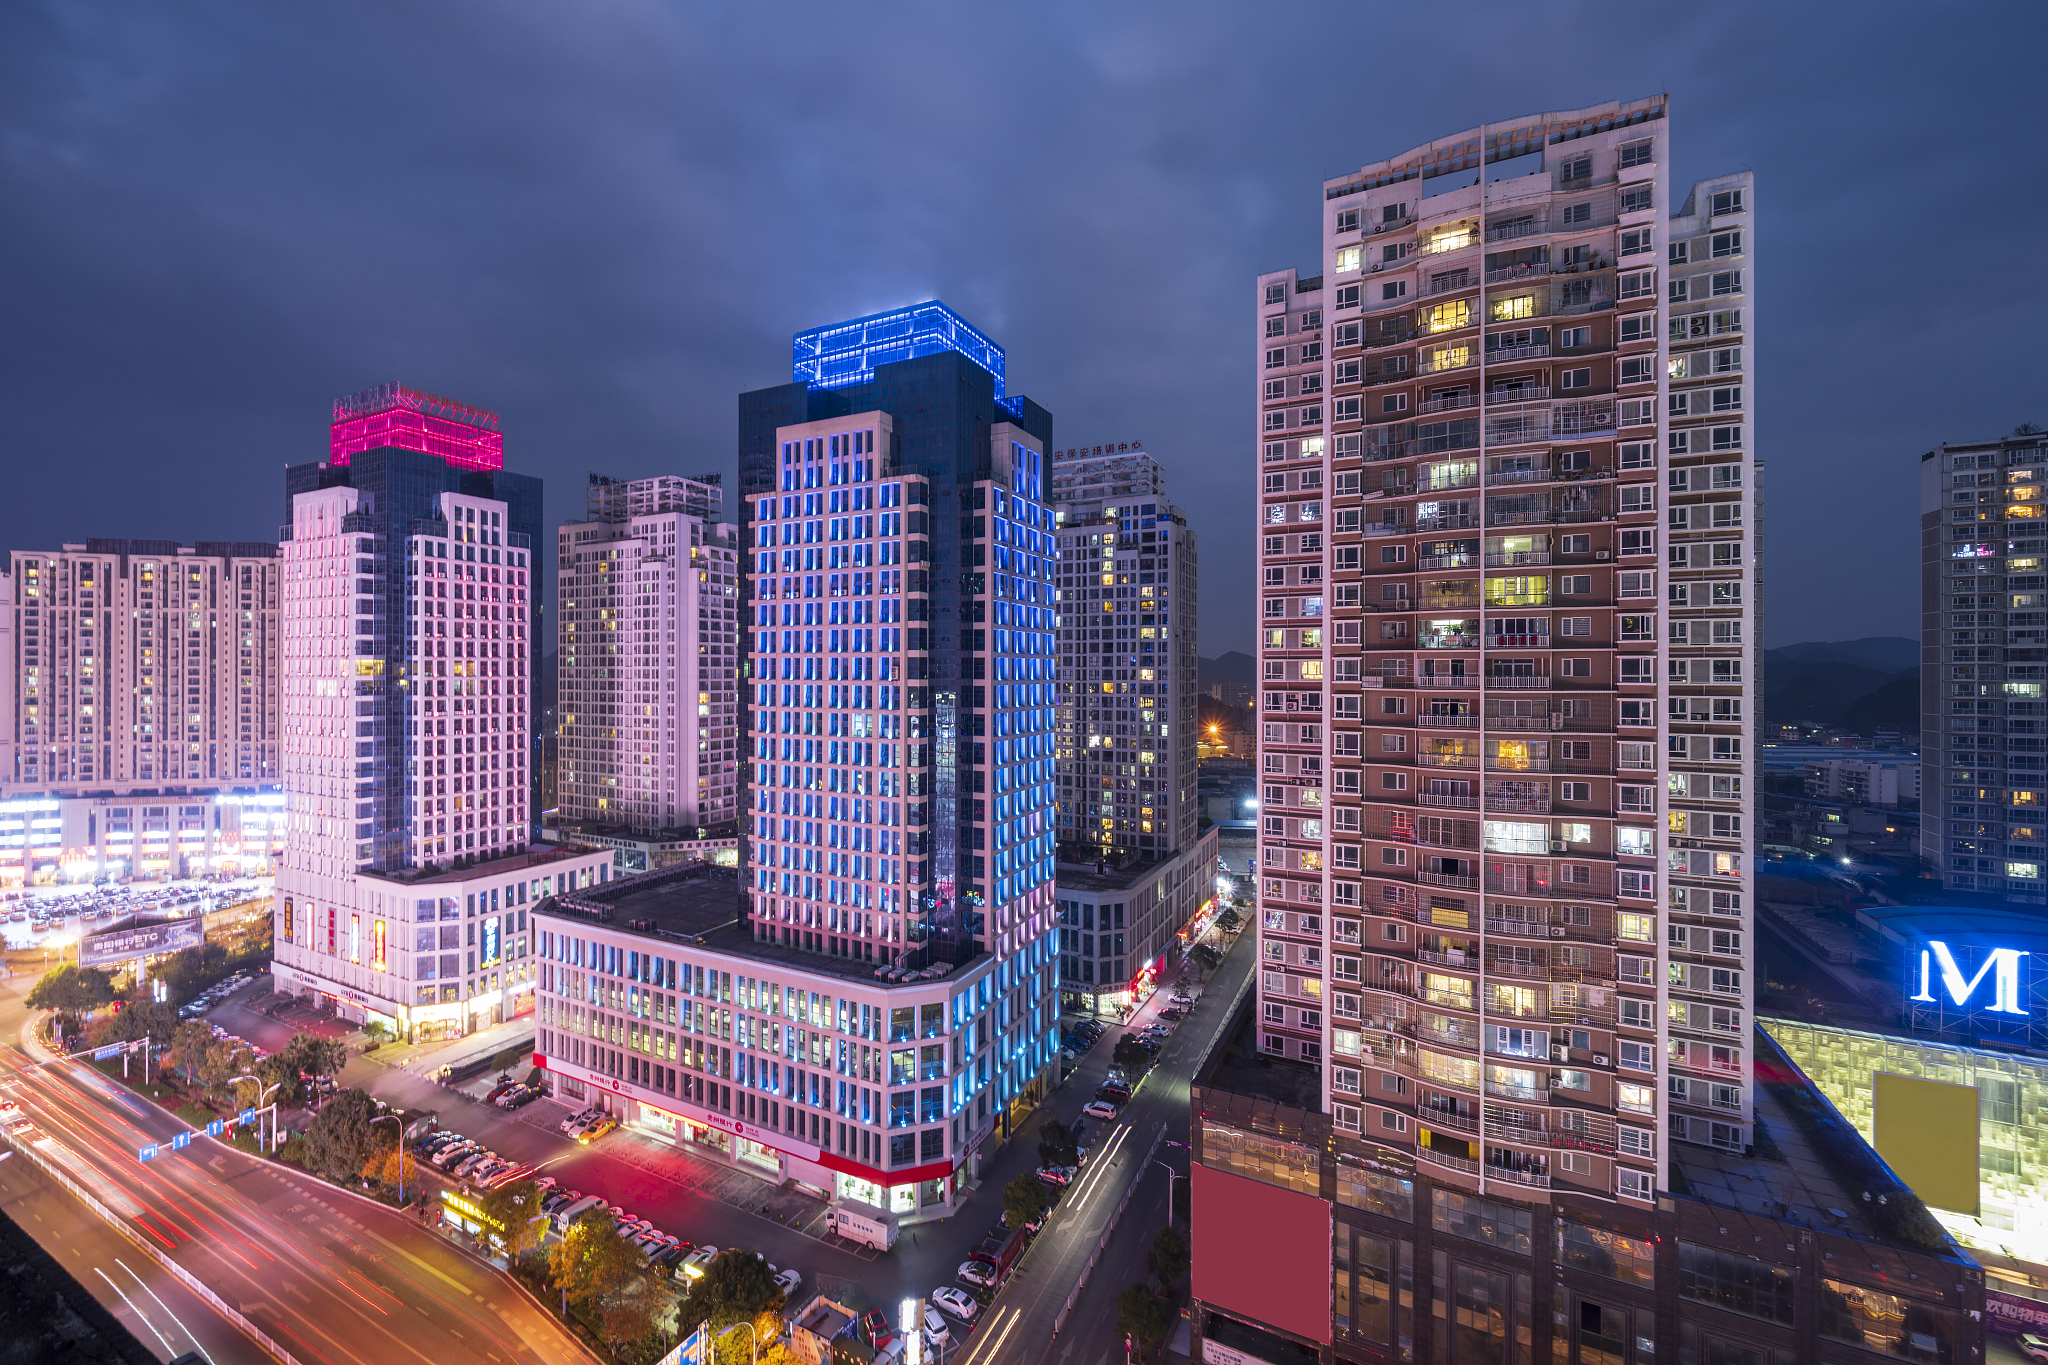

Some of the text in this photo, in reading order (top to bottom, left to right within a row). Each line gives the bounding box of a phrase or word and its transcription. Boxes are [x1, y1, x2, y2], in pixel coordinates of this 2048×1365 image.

[1054, 440, 1142, 460] 安保安培训中心
[1910, 940, 2030, 1016] M
[589, 1073, 611, 1086] 贵州银行
[707, 1113, 733, 1128] 贵州银行
